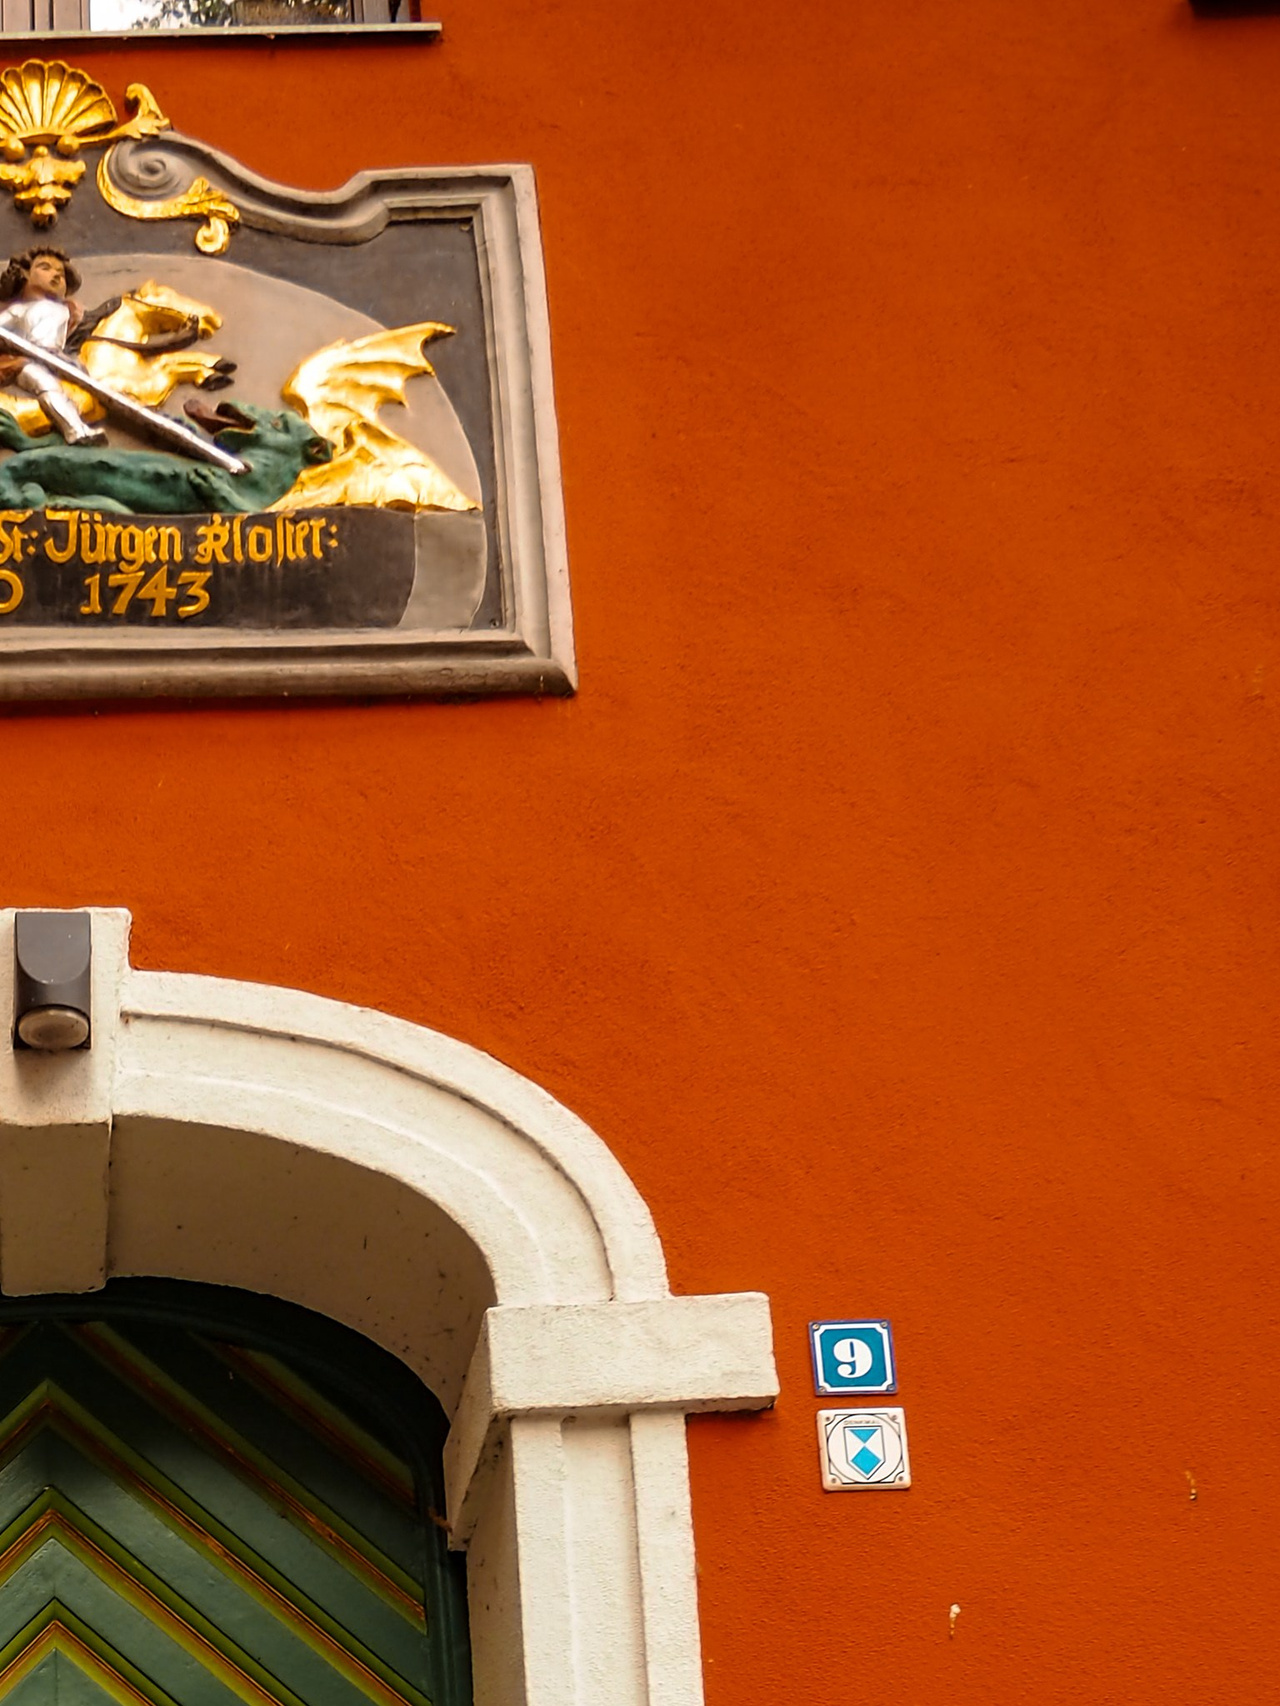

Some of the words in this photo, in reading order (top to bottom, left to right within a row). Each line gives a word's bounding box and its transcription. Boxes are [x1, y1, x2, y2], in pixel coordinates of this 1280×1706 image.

[45, 509, 182, 573] Jürgen
[80, 566, 212, 618] 1743
[833, 1338, 873, 1378] 9
